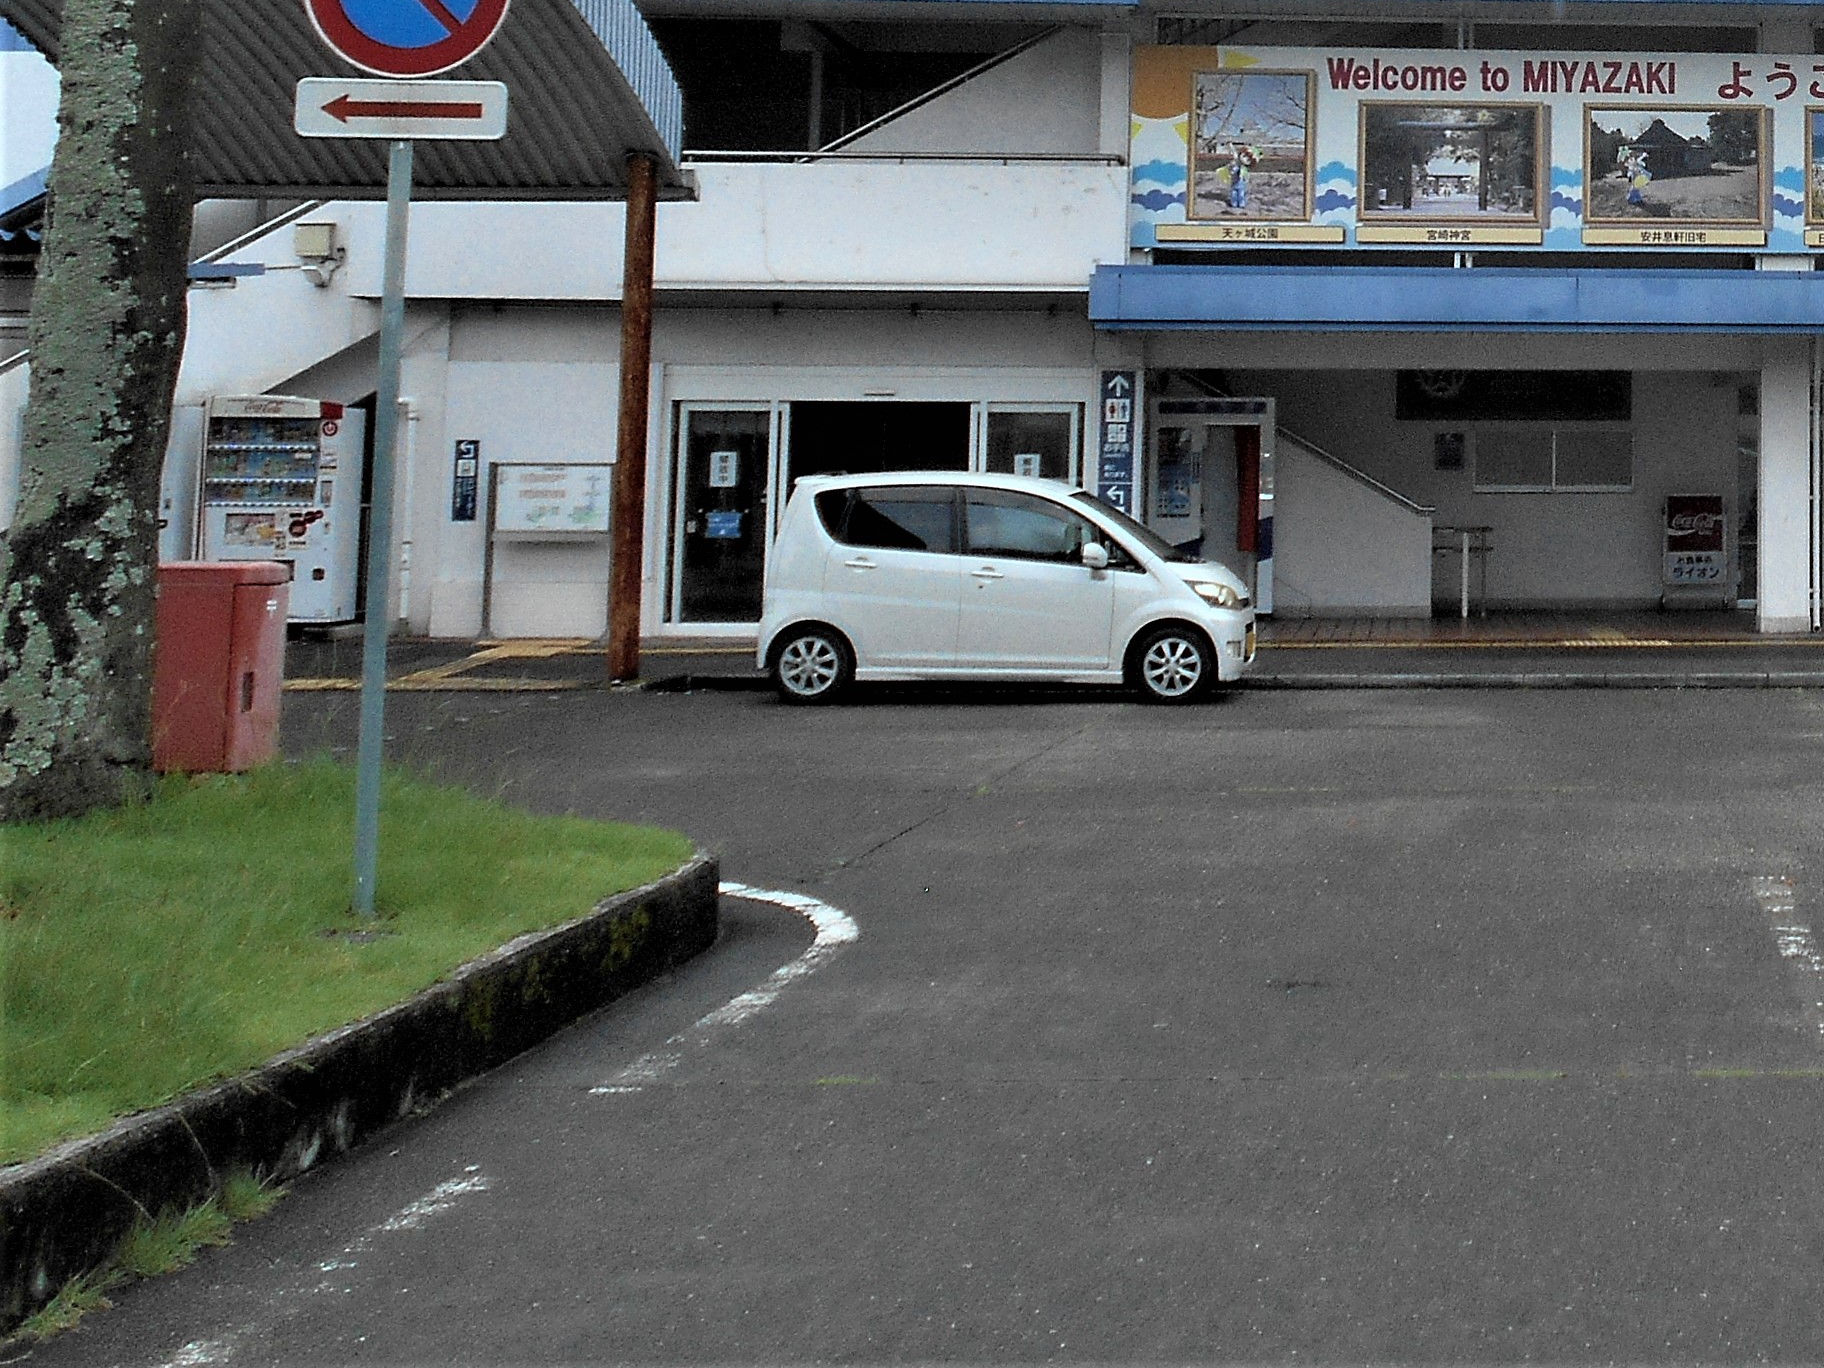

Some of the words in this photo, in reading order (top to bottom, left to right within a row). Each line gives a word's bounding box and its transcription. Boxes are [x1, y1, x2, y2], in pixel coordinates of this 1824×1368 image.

[1326, 57, 1467, 92] Welcome
[1480, 60, 1510, 92] to
[1523, 60, 1676, 95] MIYAZAKI
[1426, 229, 1471, 241] 宮崎神宮
